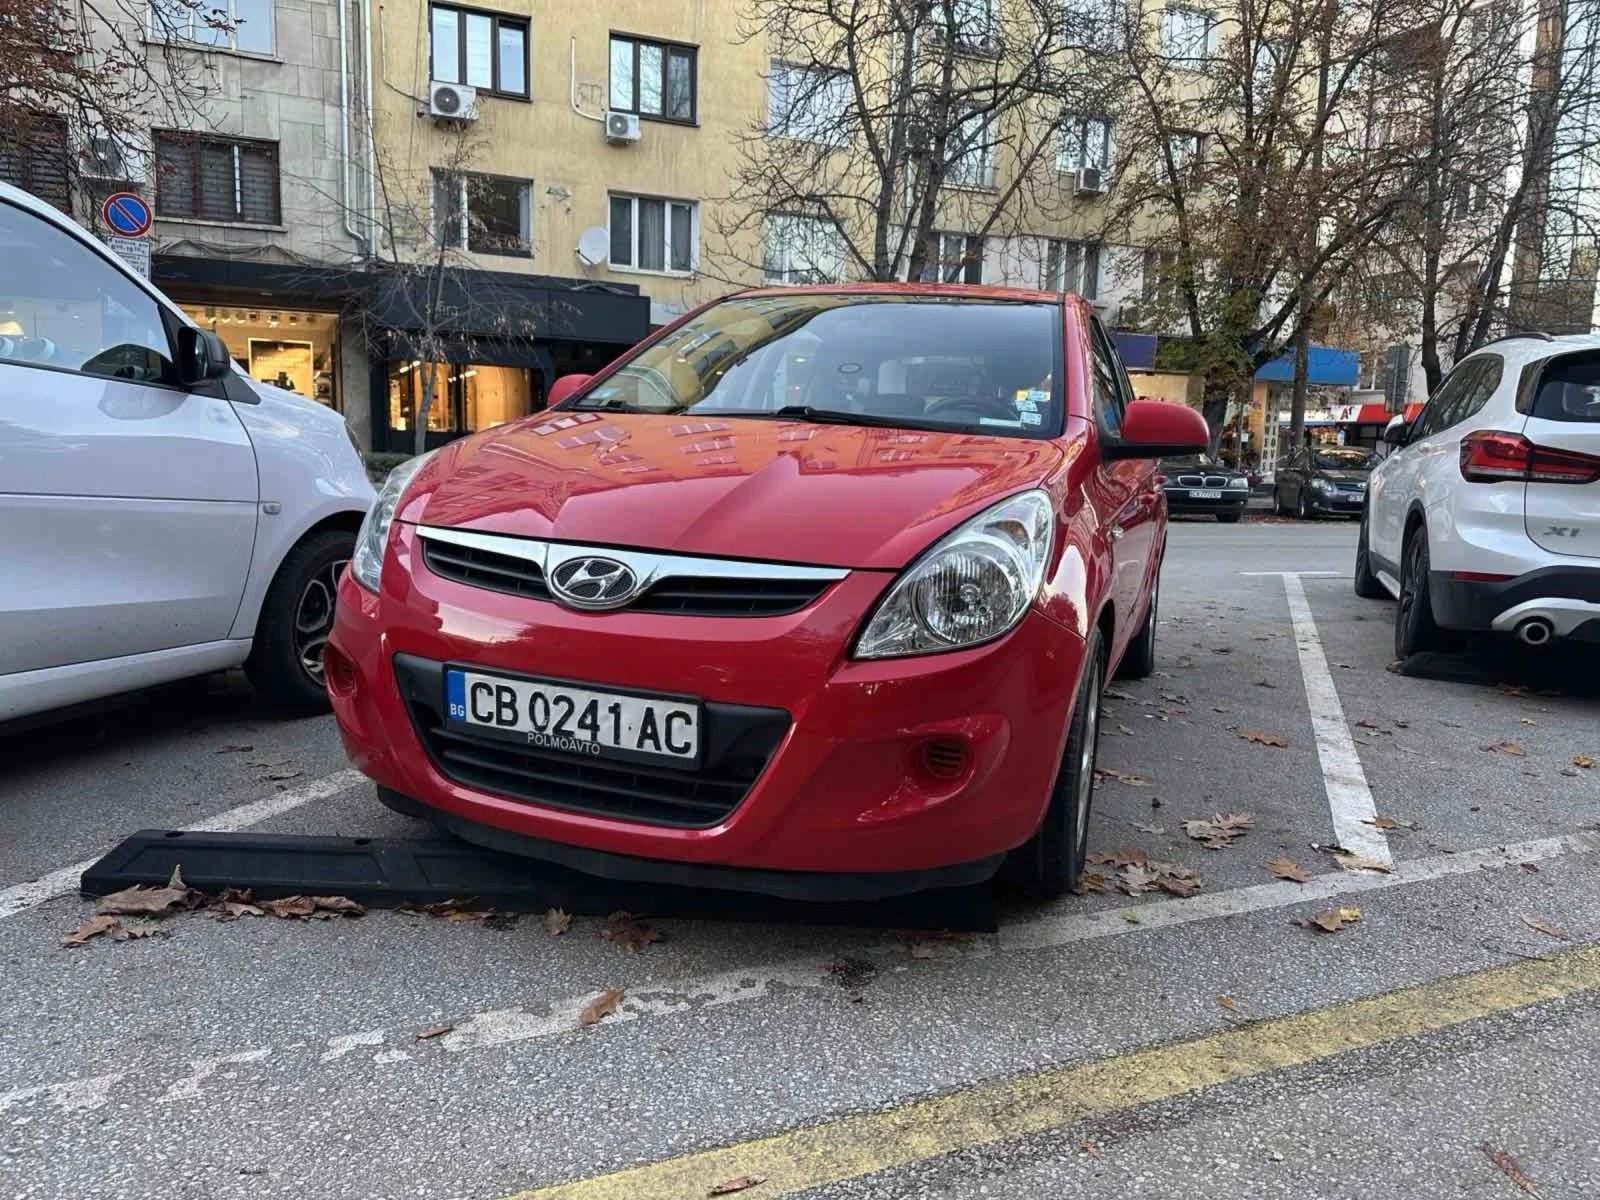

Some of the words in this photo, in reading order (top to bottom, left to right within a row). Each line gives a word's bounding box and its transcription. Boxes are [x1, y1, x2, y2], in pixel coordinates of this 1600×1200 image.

[450, 703, 465, 717] BG
[470, 681, 519, 727] CB
[528, 691, 622, 746] 0241
[636, 707, 692, 754] AC
[527, 732, 600, 755] POLMOAVTO
